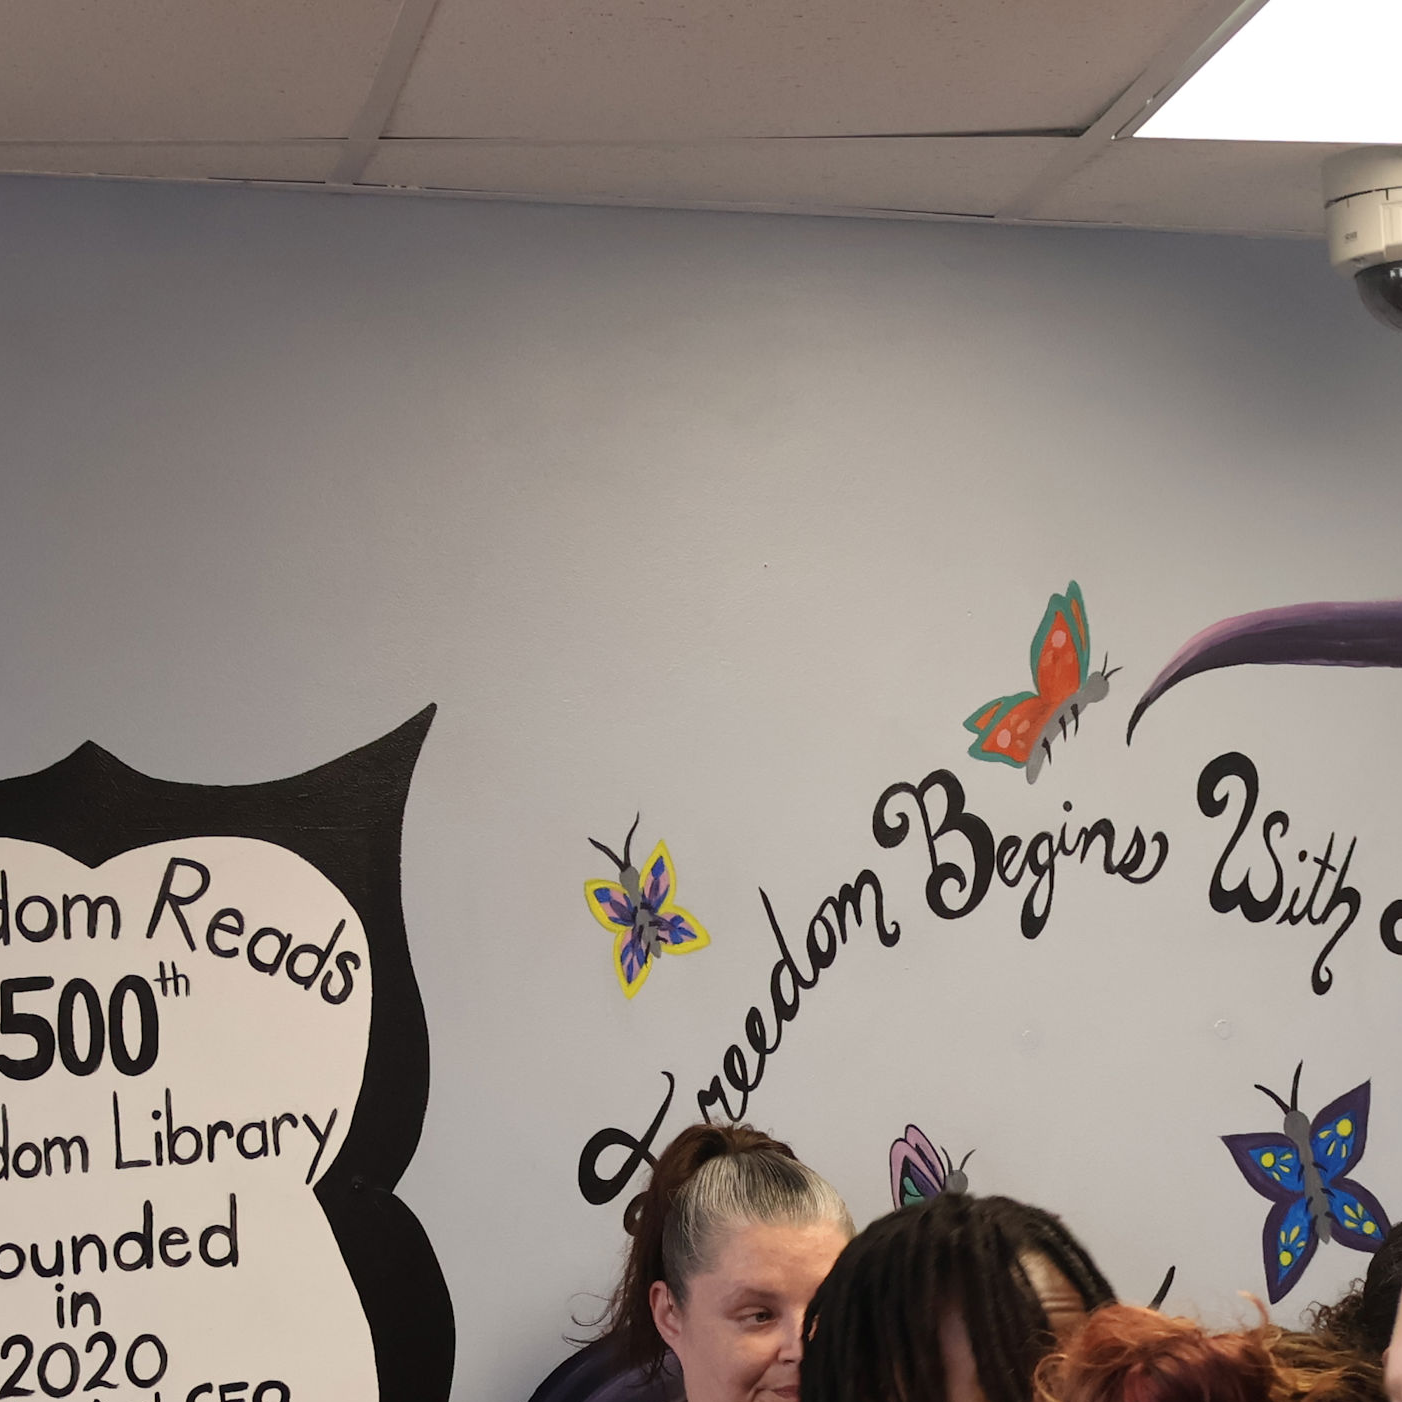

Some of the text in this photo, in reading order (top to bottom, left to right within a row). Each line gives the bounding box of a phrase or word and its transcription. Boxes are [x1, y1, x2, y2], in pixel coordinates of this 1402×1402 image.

[147, 857, 362, 1005] Reads
[579, 868, 901, 1205] Freedom
[873, 768, 1169, 940] Begins
[1196, 751, 1361, 997] With
[113, 1088, 339, 1185] Library
[55, 1283, 102, 1329] in
